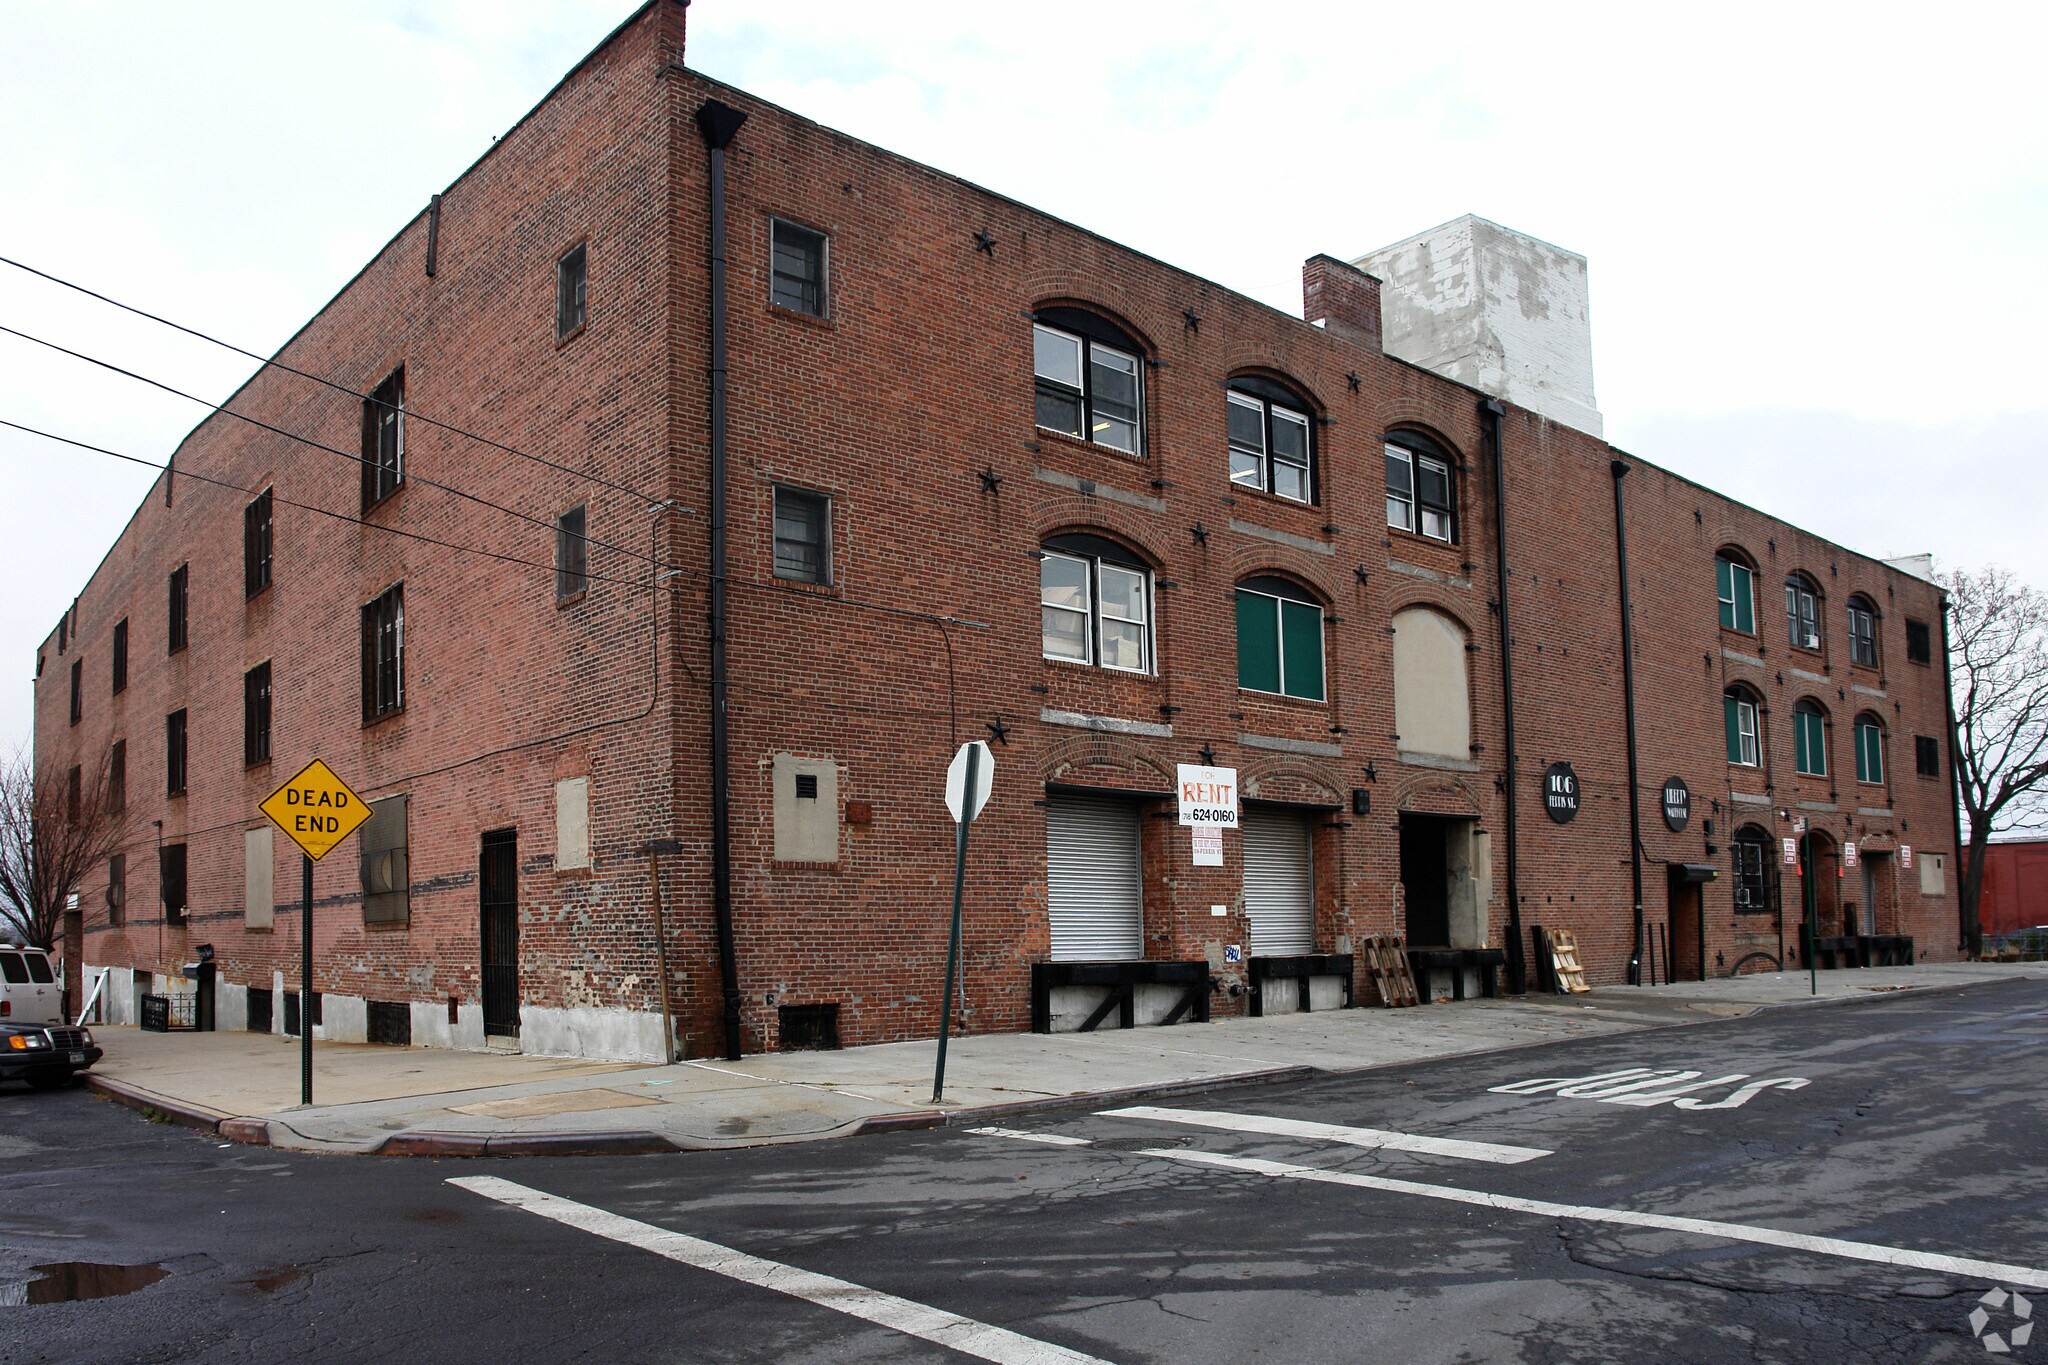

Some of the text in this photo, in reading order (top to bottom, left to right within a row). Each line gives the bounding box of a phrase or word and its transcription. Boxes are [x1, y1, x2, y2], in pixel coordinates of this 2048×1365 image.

[1183, 782, 1232, 804] RENT
[1550, 775, 1574, 794] 106
[287, 788, 348, 808] DEAD
[1549, 795, 1577, 809] FERRIS ST.
[1665, 788, 1687, 804] LIBERTY
[295, 814, 339, 833] END
[1487, 1067, 1813, 1111] STOP
